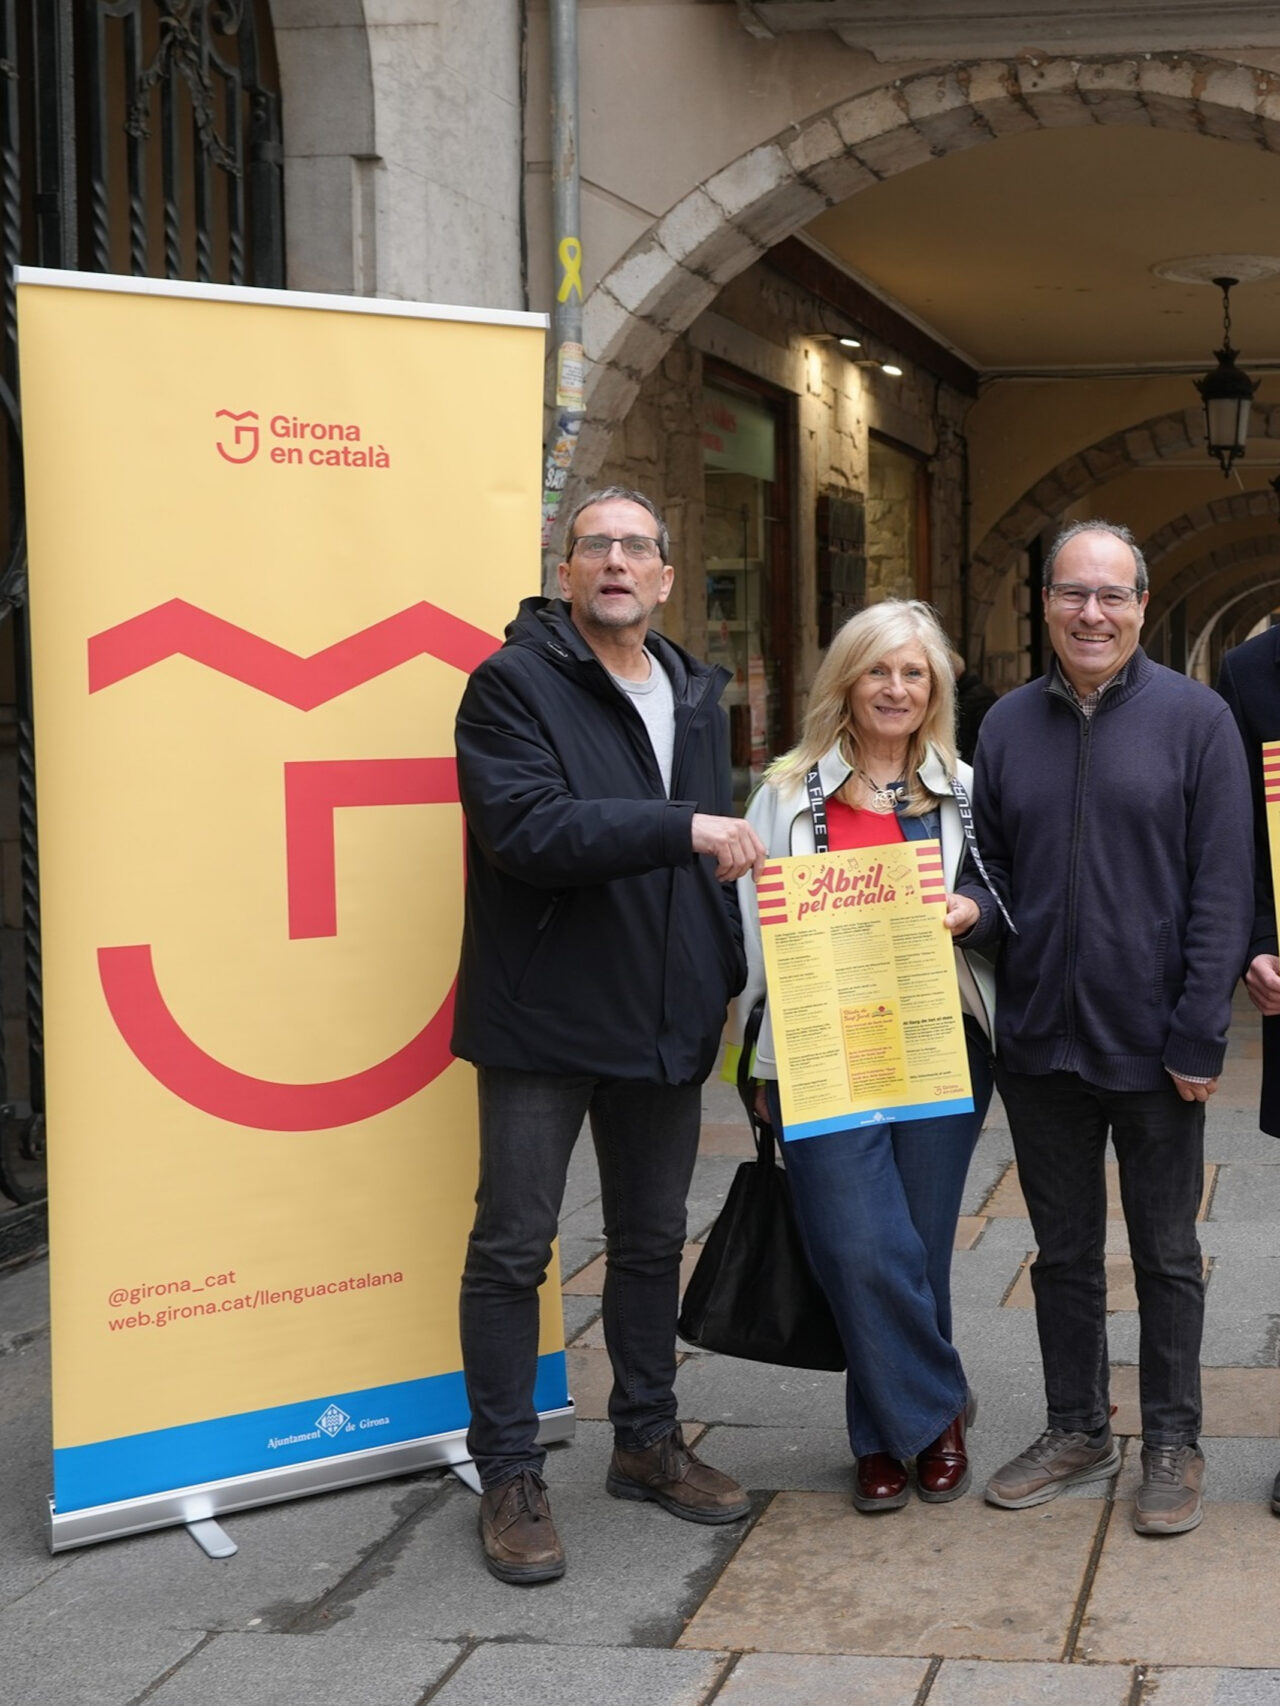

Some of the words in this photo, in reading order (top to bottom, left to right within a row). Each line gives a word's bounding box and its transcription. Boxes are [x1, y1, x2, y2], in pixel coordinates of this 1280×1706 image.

[270, 415, 361, 441] Girona
[270, 446, 303, 464] en
[308, 445, 390, 468] català
[809, 787, 827, 835] FILLE
[807, 863, 883, 897] Abril
[797, 892, 828, 921] pel
[832, 884, 896, 909] català
[108, 1270, 237, 1308] @girona_cat
[108, 1272, 404, 1331] web.girona.cat/llenguacatalana
[267, 1429, 321, 1449] Ajuntament
[345, 1422, 356, 1432] de
[359, 1416, 390, 1429] Girona
